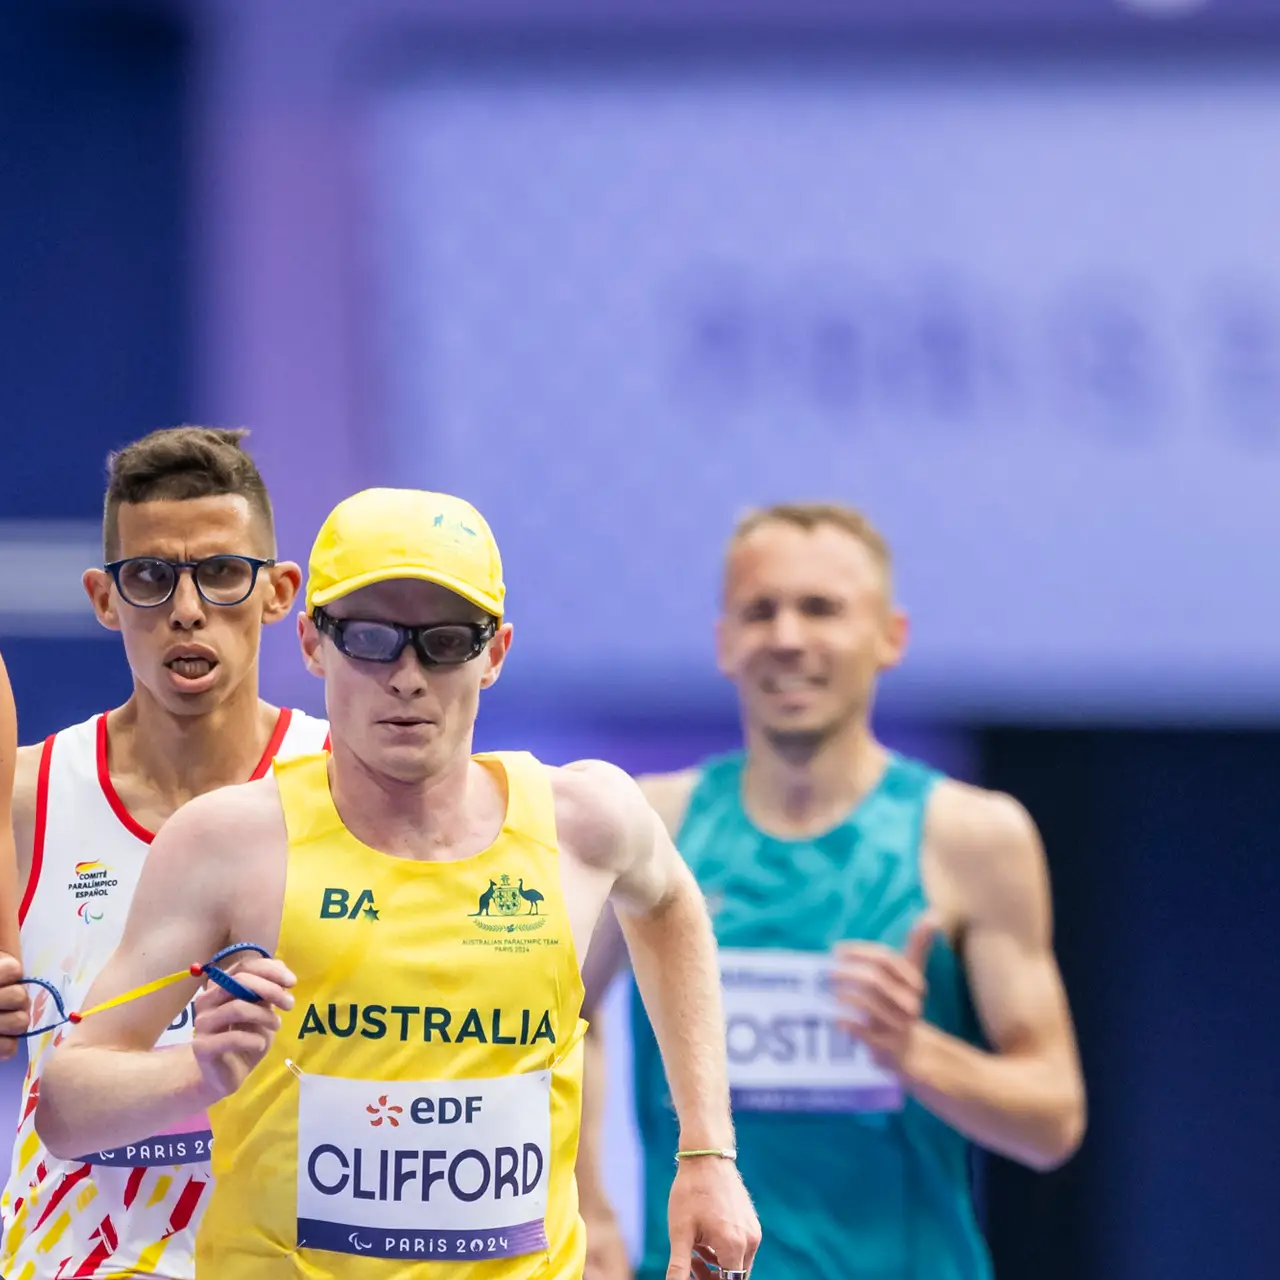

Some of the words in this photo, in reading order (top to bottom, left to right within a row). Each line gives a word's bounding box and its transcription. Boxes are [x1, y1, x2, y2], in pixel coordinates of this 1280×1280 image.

[79, 869, 107, 880] COMITÉ
[75, 888, 108, 898] ESPAÑOL
[298, 1003, 557, 1045] AUSTRALIA
[307, 1143, 544, 1203] CLIFFORD
[456, 1236, 508, 1253] 2024
